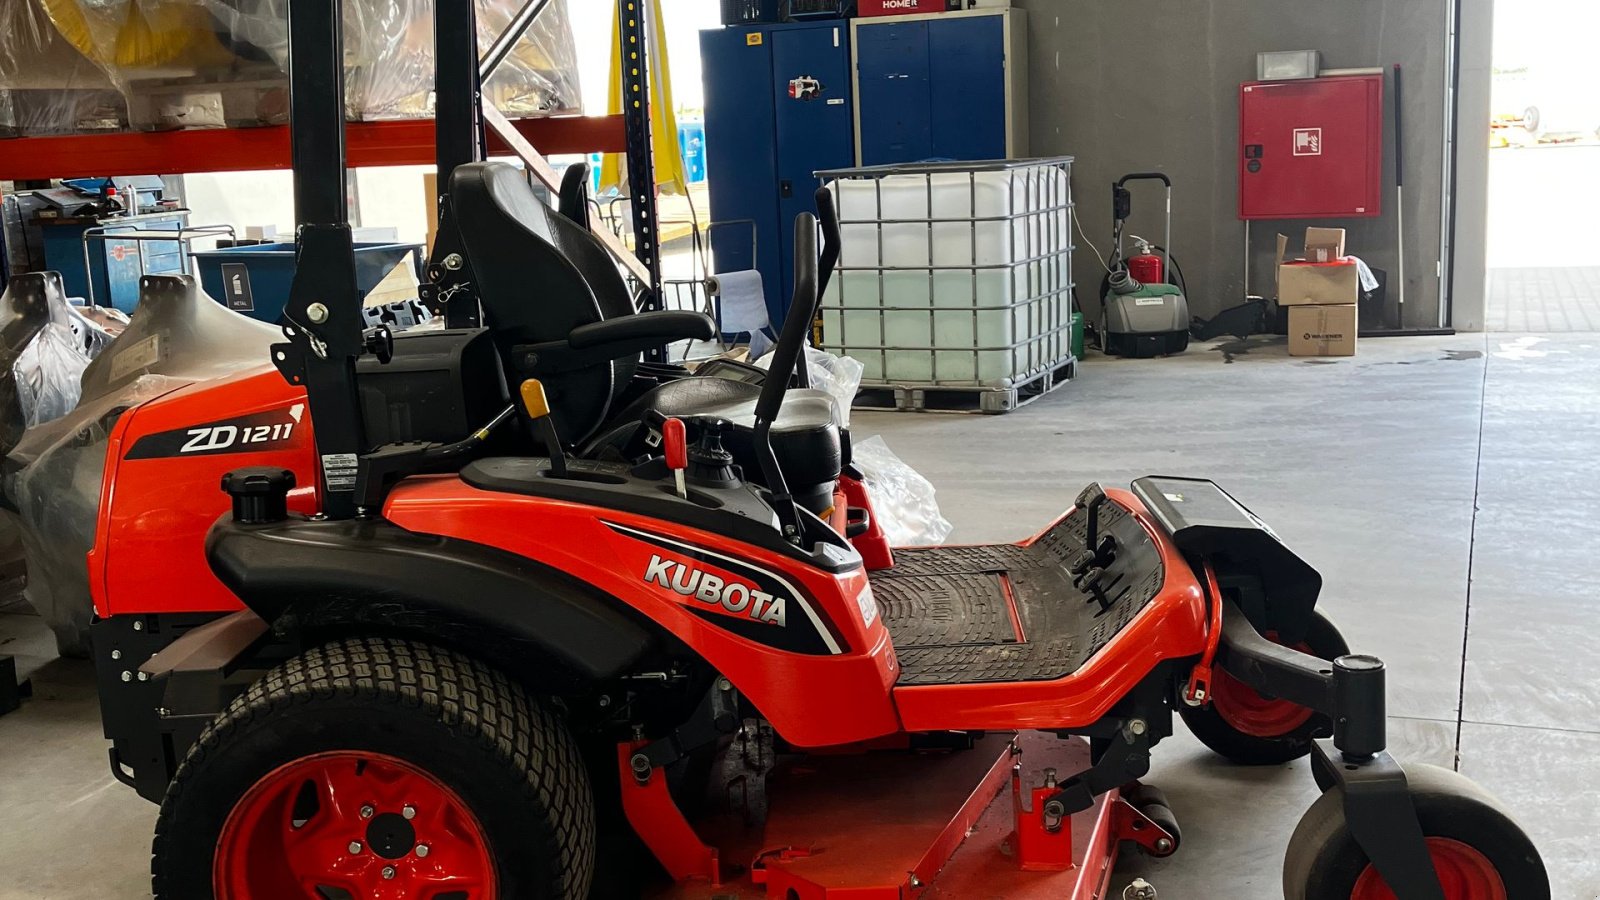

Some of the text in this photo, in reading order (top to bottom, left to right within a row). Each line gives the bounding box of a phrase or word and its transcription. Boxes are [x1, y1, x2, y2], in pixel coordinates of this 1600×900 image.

[180, 422, 294, 453] ZD 1211
[643, 553, 787, 628] KUBOTA
